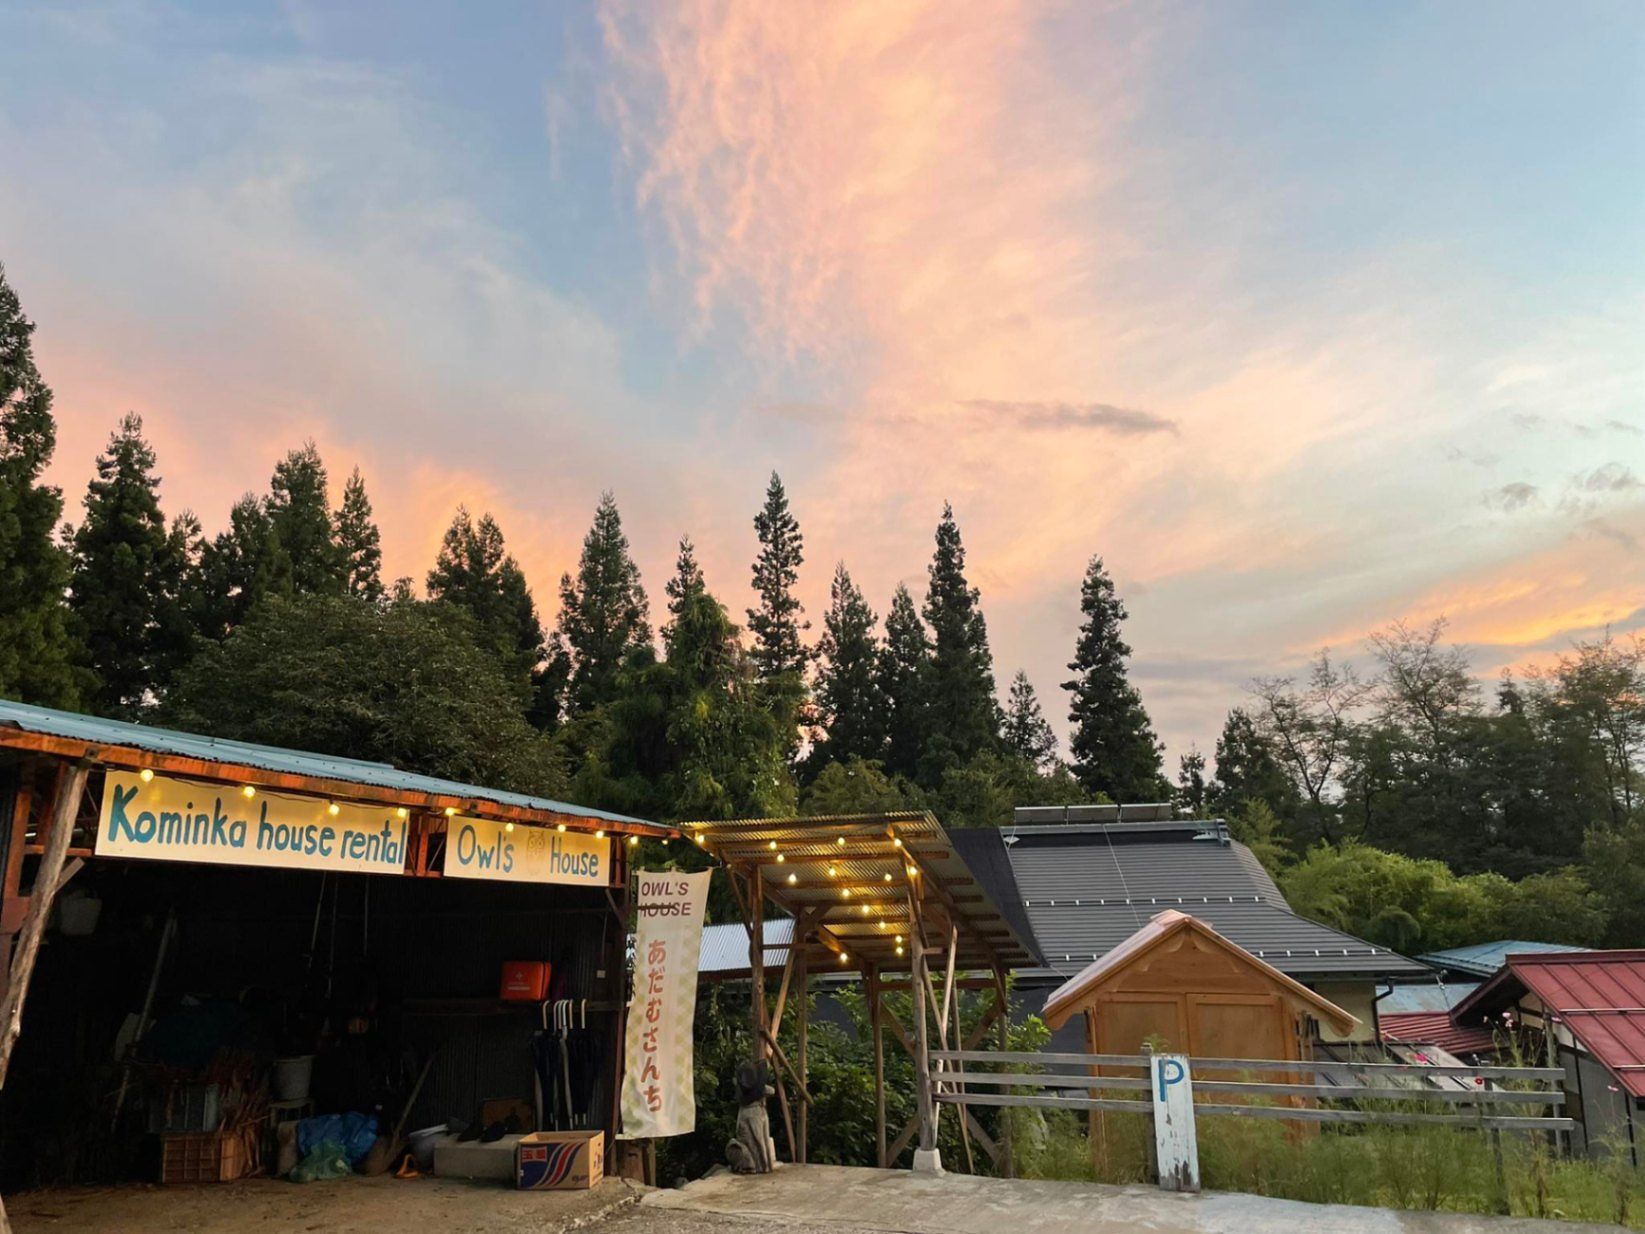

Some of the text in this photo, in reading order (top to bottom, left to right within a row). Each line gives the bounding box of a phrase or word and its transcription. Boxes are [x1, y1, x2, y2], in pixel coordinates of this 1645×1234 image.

[108, 783, 407, 864] Kominka house rental
[457, 824, 599, 877] Owl's House
[640, 902, 692, 917] HOUSE
[641, 881, 689, 896] OWL'S
[640, 939, 666, 1112] あだむさんち
[1158, 1059, 1185, 1102] P
